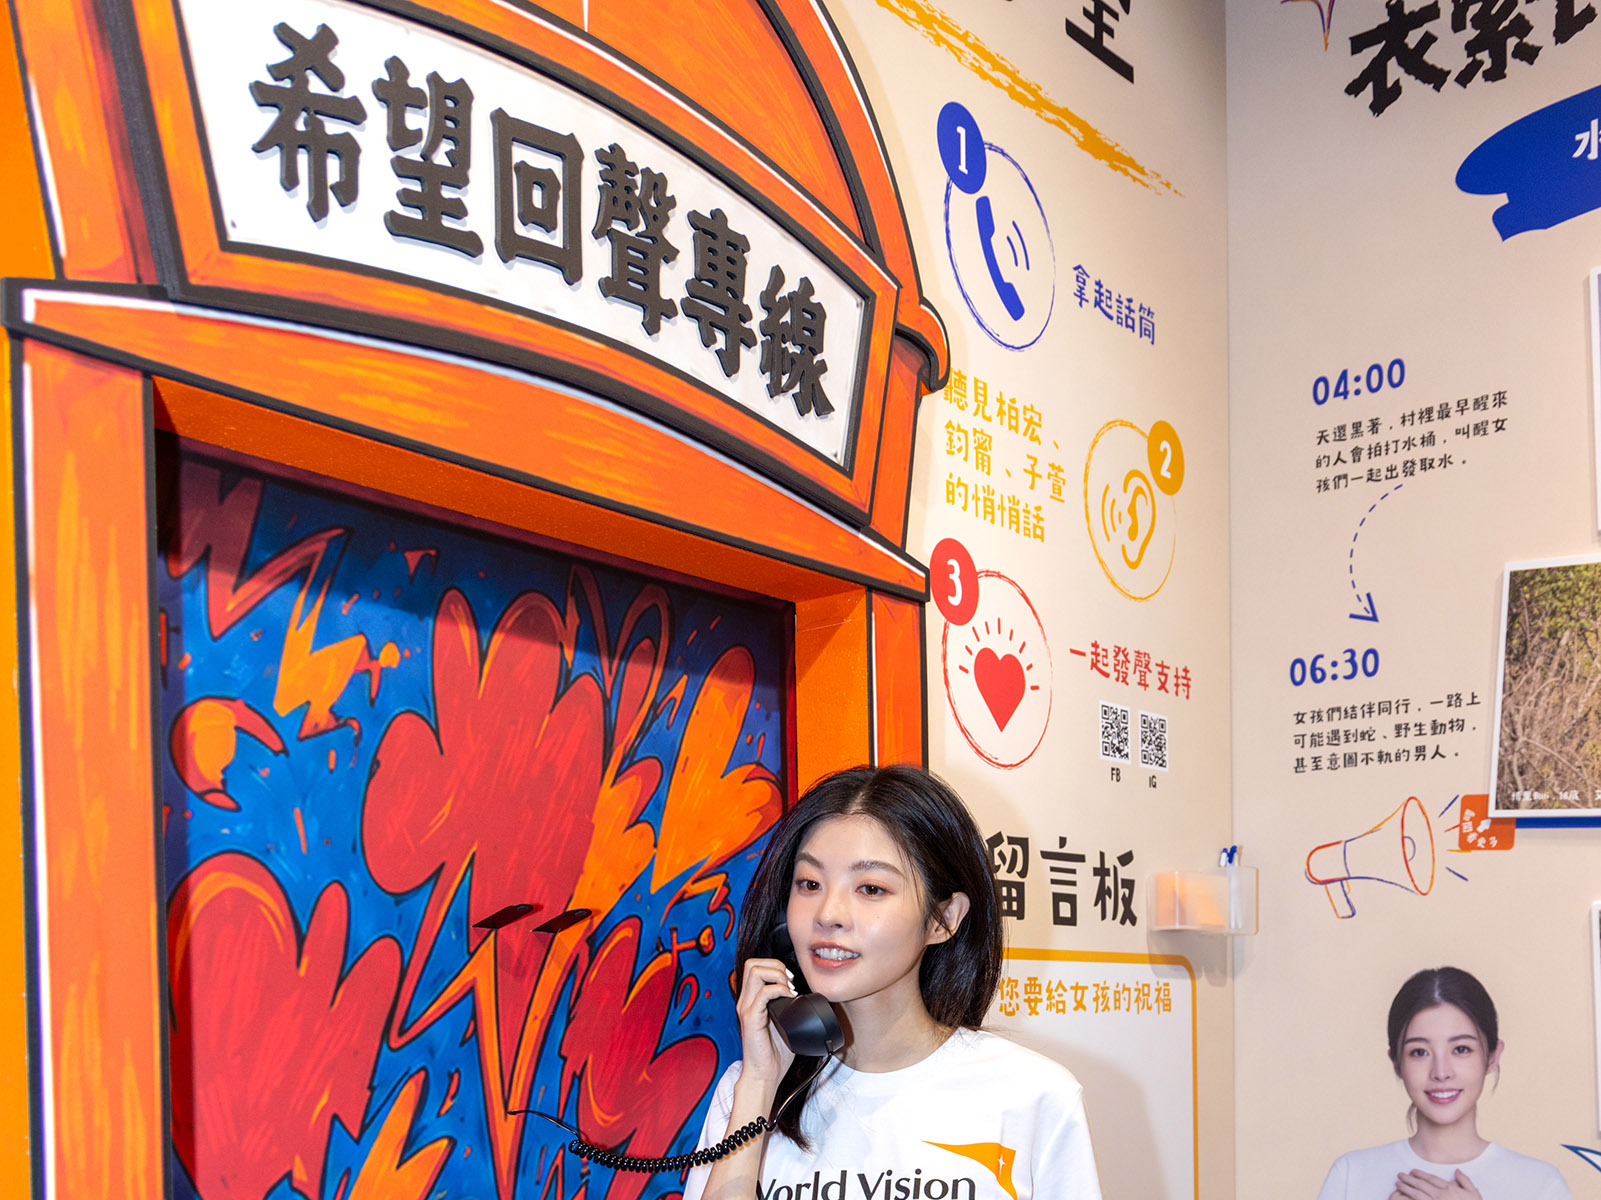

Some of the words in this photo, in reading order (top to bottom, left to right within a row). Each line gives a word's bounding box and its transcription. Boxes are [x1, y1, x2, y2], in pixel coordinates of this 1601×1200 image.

[956, 125, 969, 175] 1
[249, 20, 835, 418] 希望回聲專線
[1072, 263, 1156, 346] 拿起話筒
[1312, 357, 1406, 406] 04:00
[1159, 439, 1172, 480] 2
[945, 471, 1046, 543] 的悄悄話
[946, 558, 963, 607] 3
[1069, 639, 1192, 700] 一起發聲支持
[1289, 647, 1380, 687] 06:30
[1110, 766, 1121, 783] FB
[1148, 774, 1157, 789] IG
[985, 831, 1138, 927] 留言板
[999, 976, 1172, 1018] 您要給女孩的祝福
